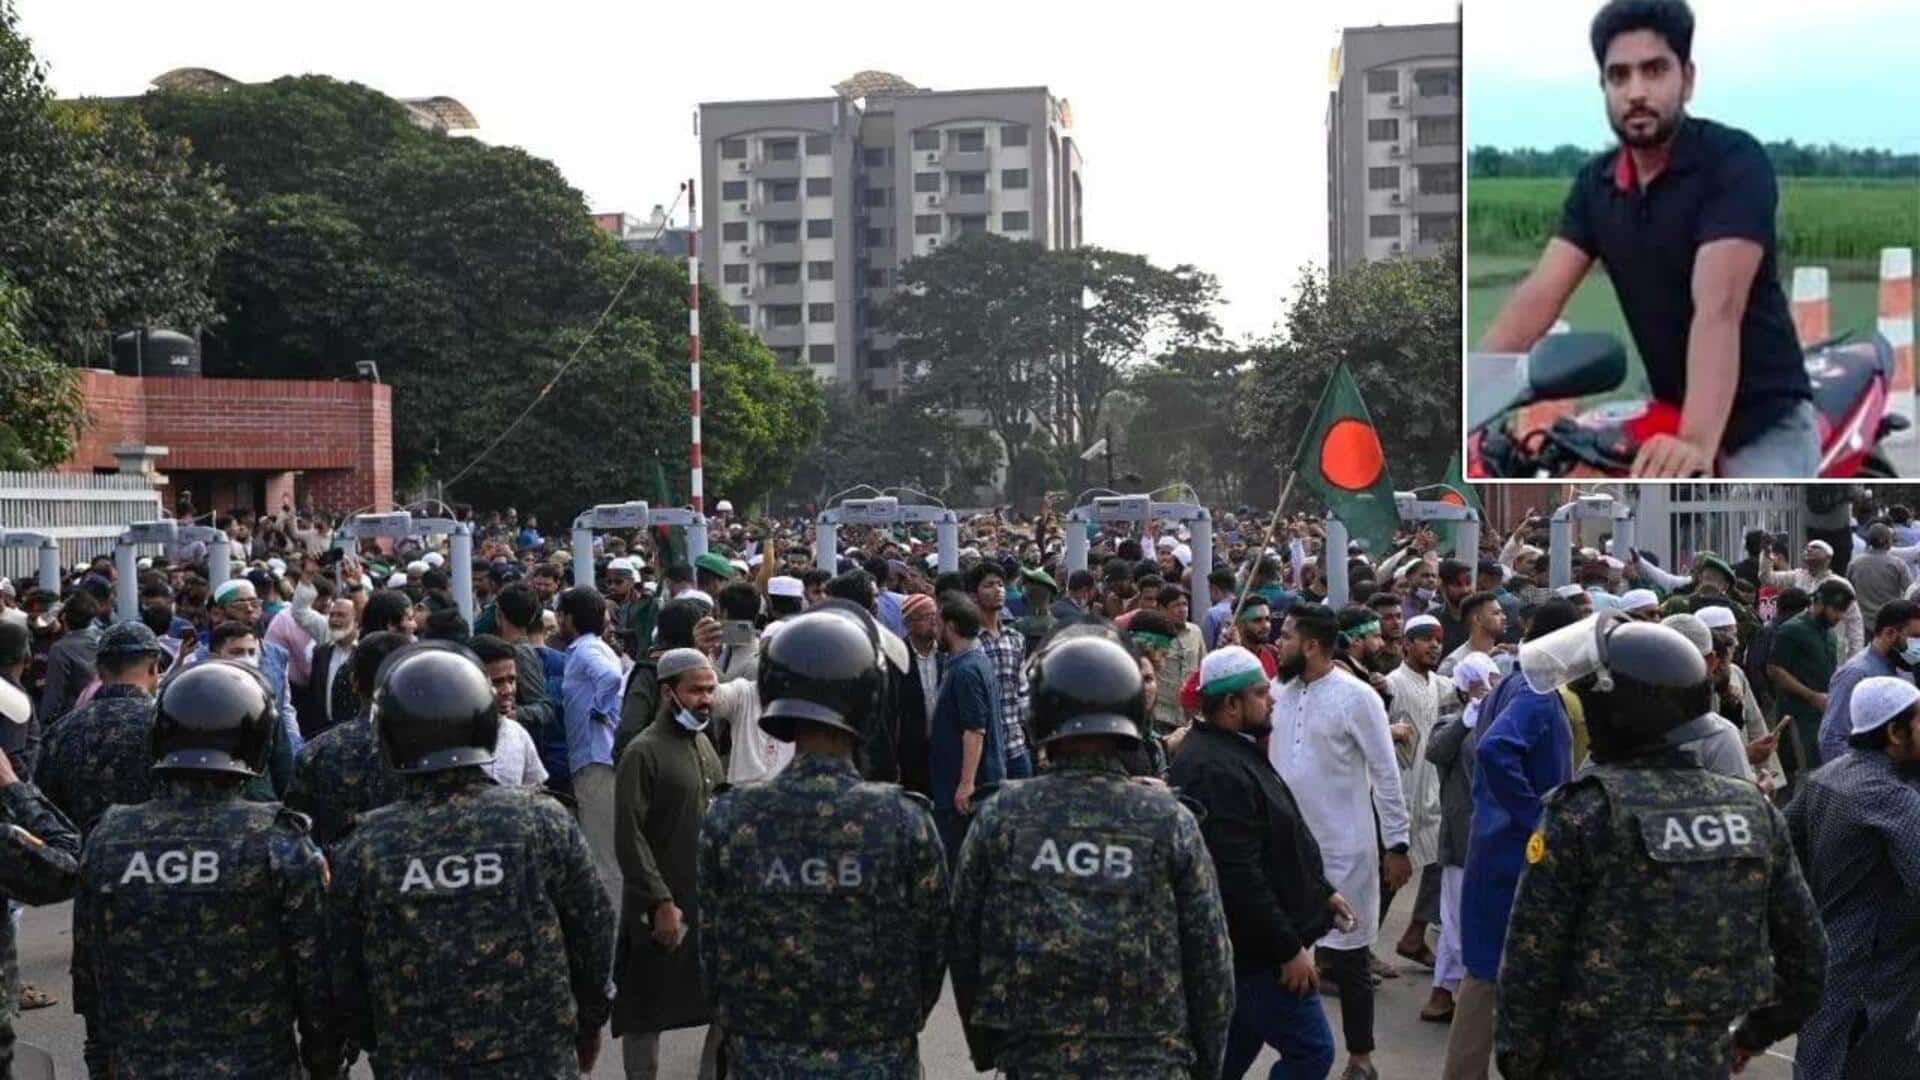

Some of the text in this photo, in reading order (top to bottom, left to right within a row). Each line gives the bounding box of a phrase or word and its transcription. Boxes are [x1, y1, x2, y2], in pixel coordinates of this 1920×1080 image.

[1662, 814, 1752, 850] AGB
[120, 850, 220, 884] AGB
[400, 853, 504, 892] AGB
[764, 853, 863, 887] AGB
[1031, 838, 1133, 879] AGB
